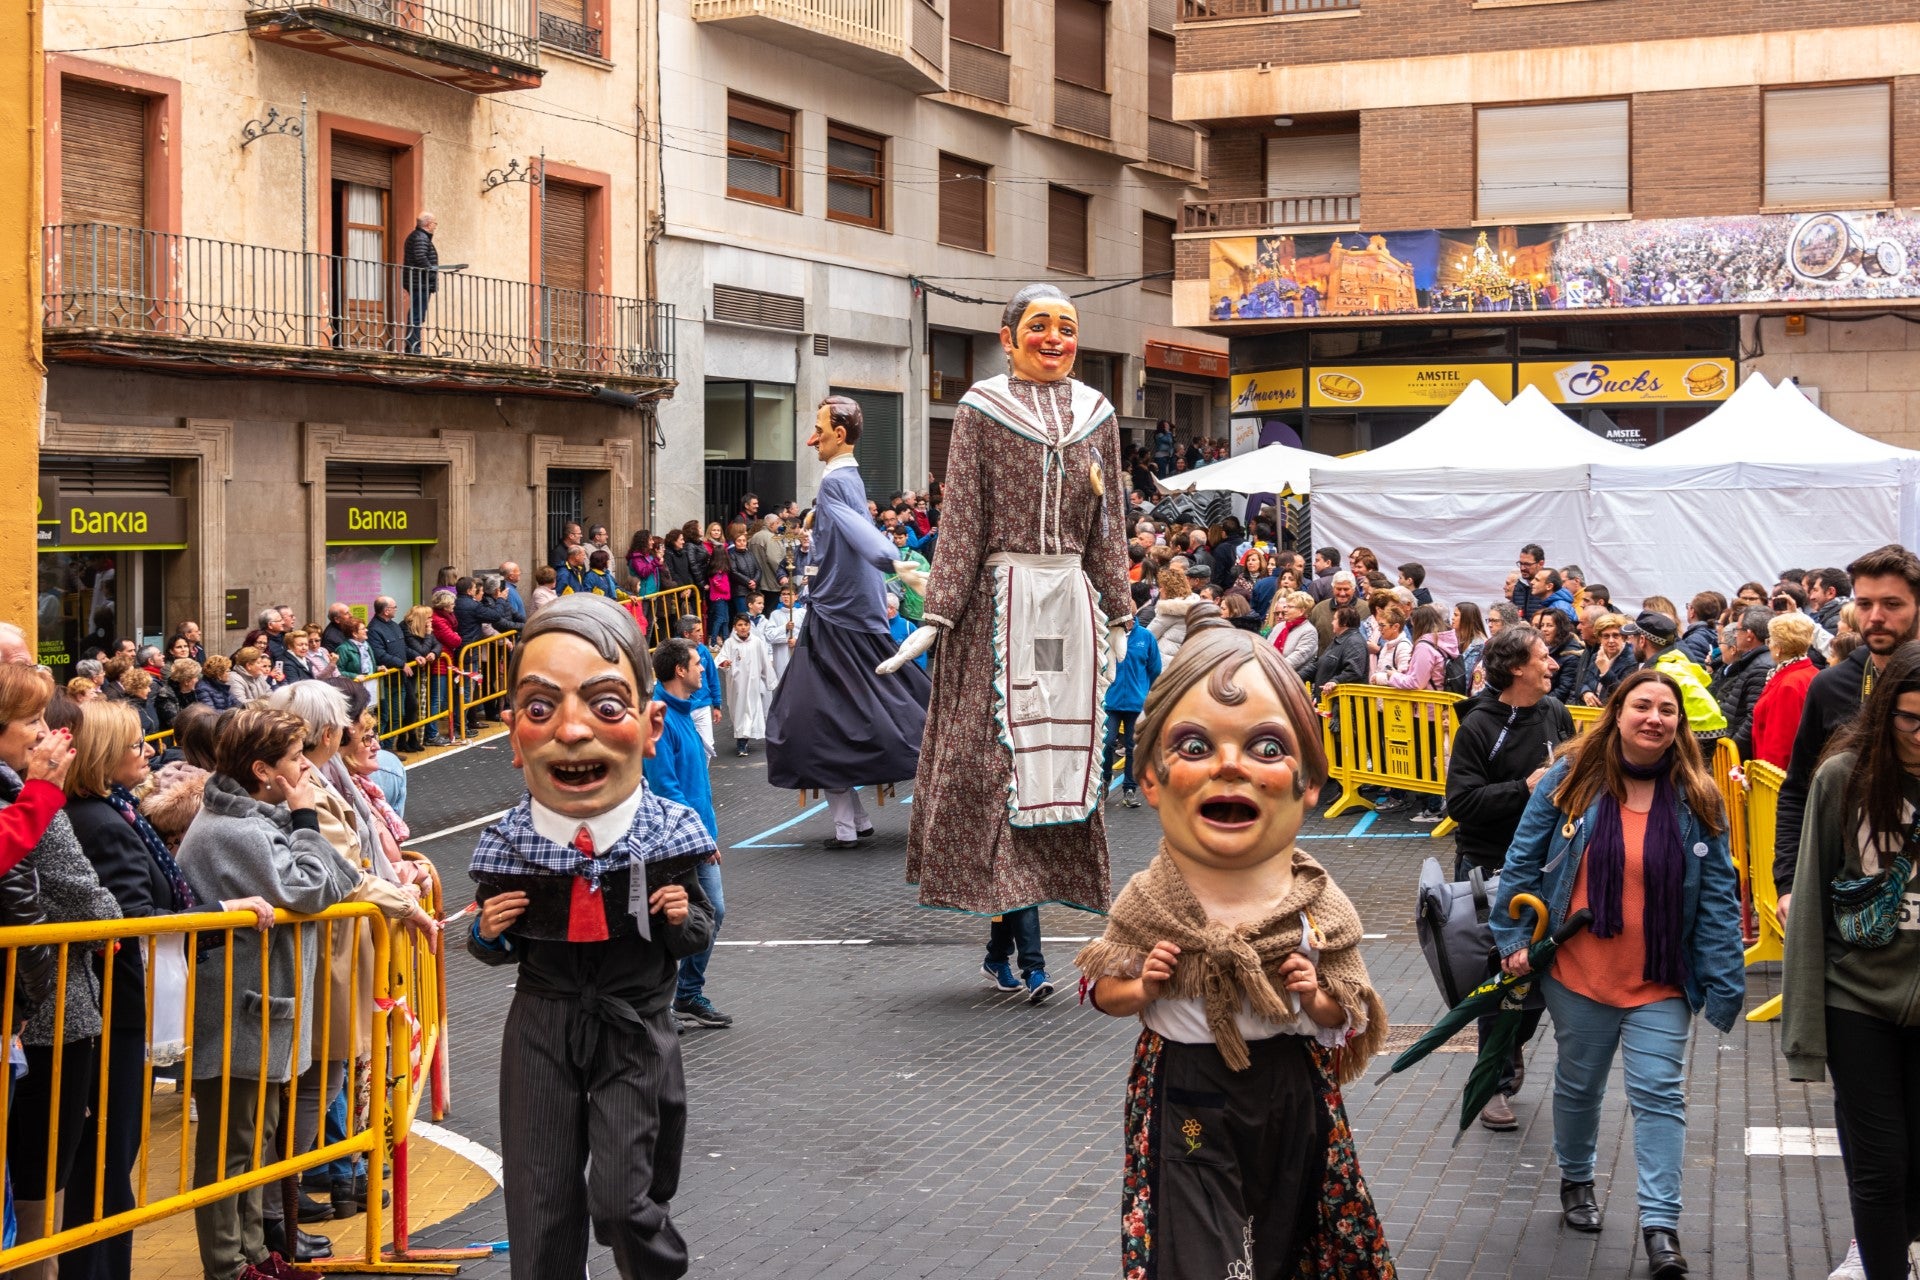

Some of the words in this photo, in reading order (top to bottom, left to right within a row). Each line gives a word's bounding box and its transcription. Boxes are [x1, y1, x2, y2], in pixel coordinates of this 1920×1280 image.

[1416, 370, 1460, 381] AMSTEL
[1569, 364, 1664, 396] Bucks
[1238, 379, 1296, 407] Almuerzos
[1606, 429, 1641, 438] AMSTEL
[71, 507, 148, 534] Bankia
[349, 507, 407, 530] Bankia
